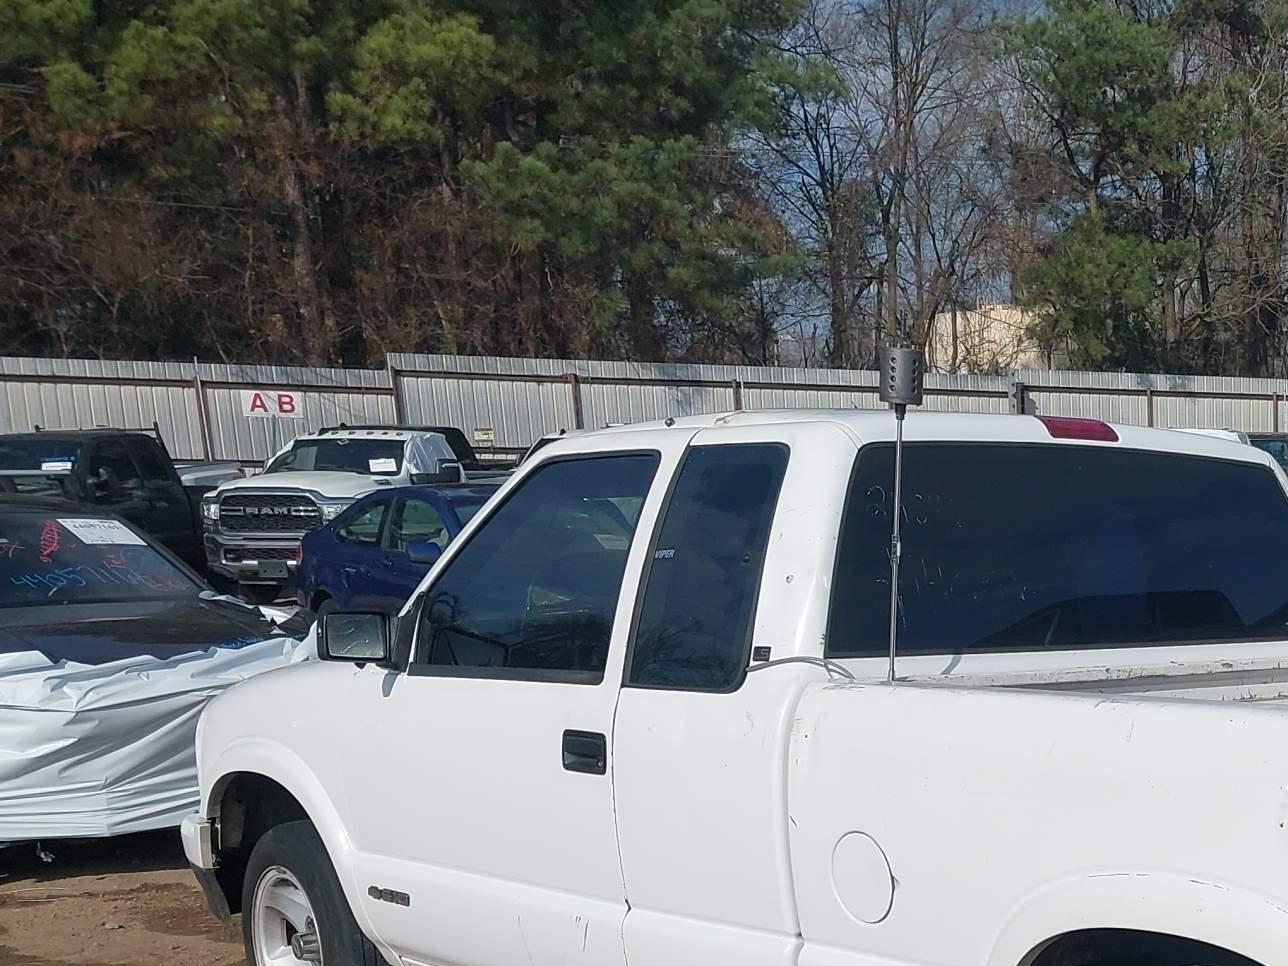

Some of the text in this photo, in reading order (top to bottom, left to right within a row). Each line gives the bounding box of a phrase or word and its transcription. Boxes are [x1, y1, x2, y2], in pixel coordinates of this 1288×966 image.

[250, 393, 296, 414] A B
[245, 507, 288, 515] RAM
[654, 549, 676, 559] VIPER
